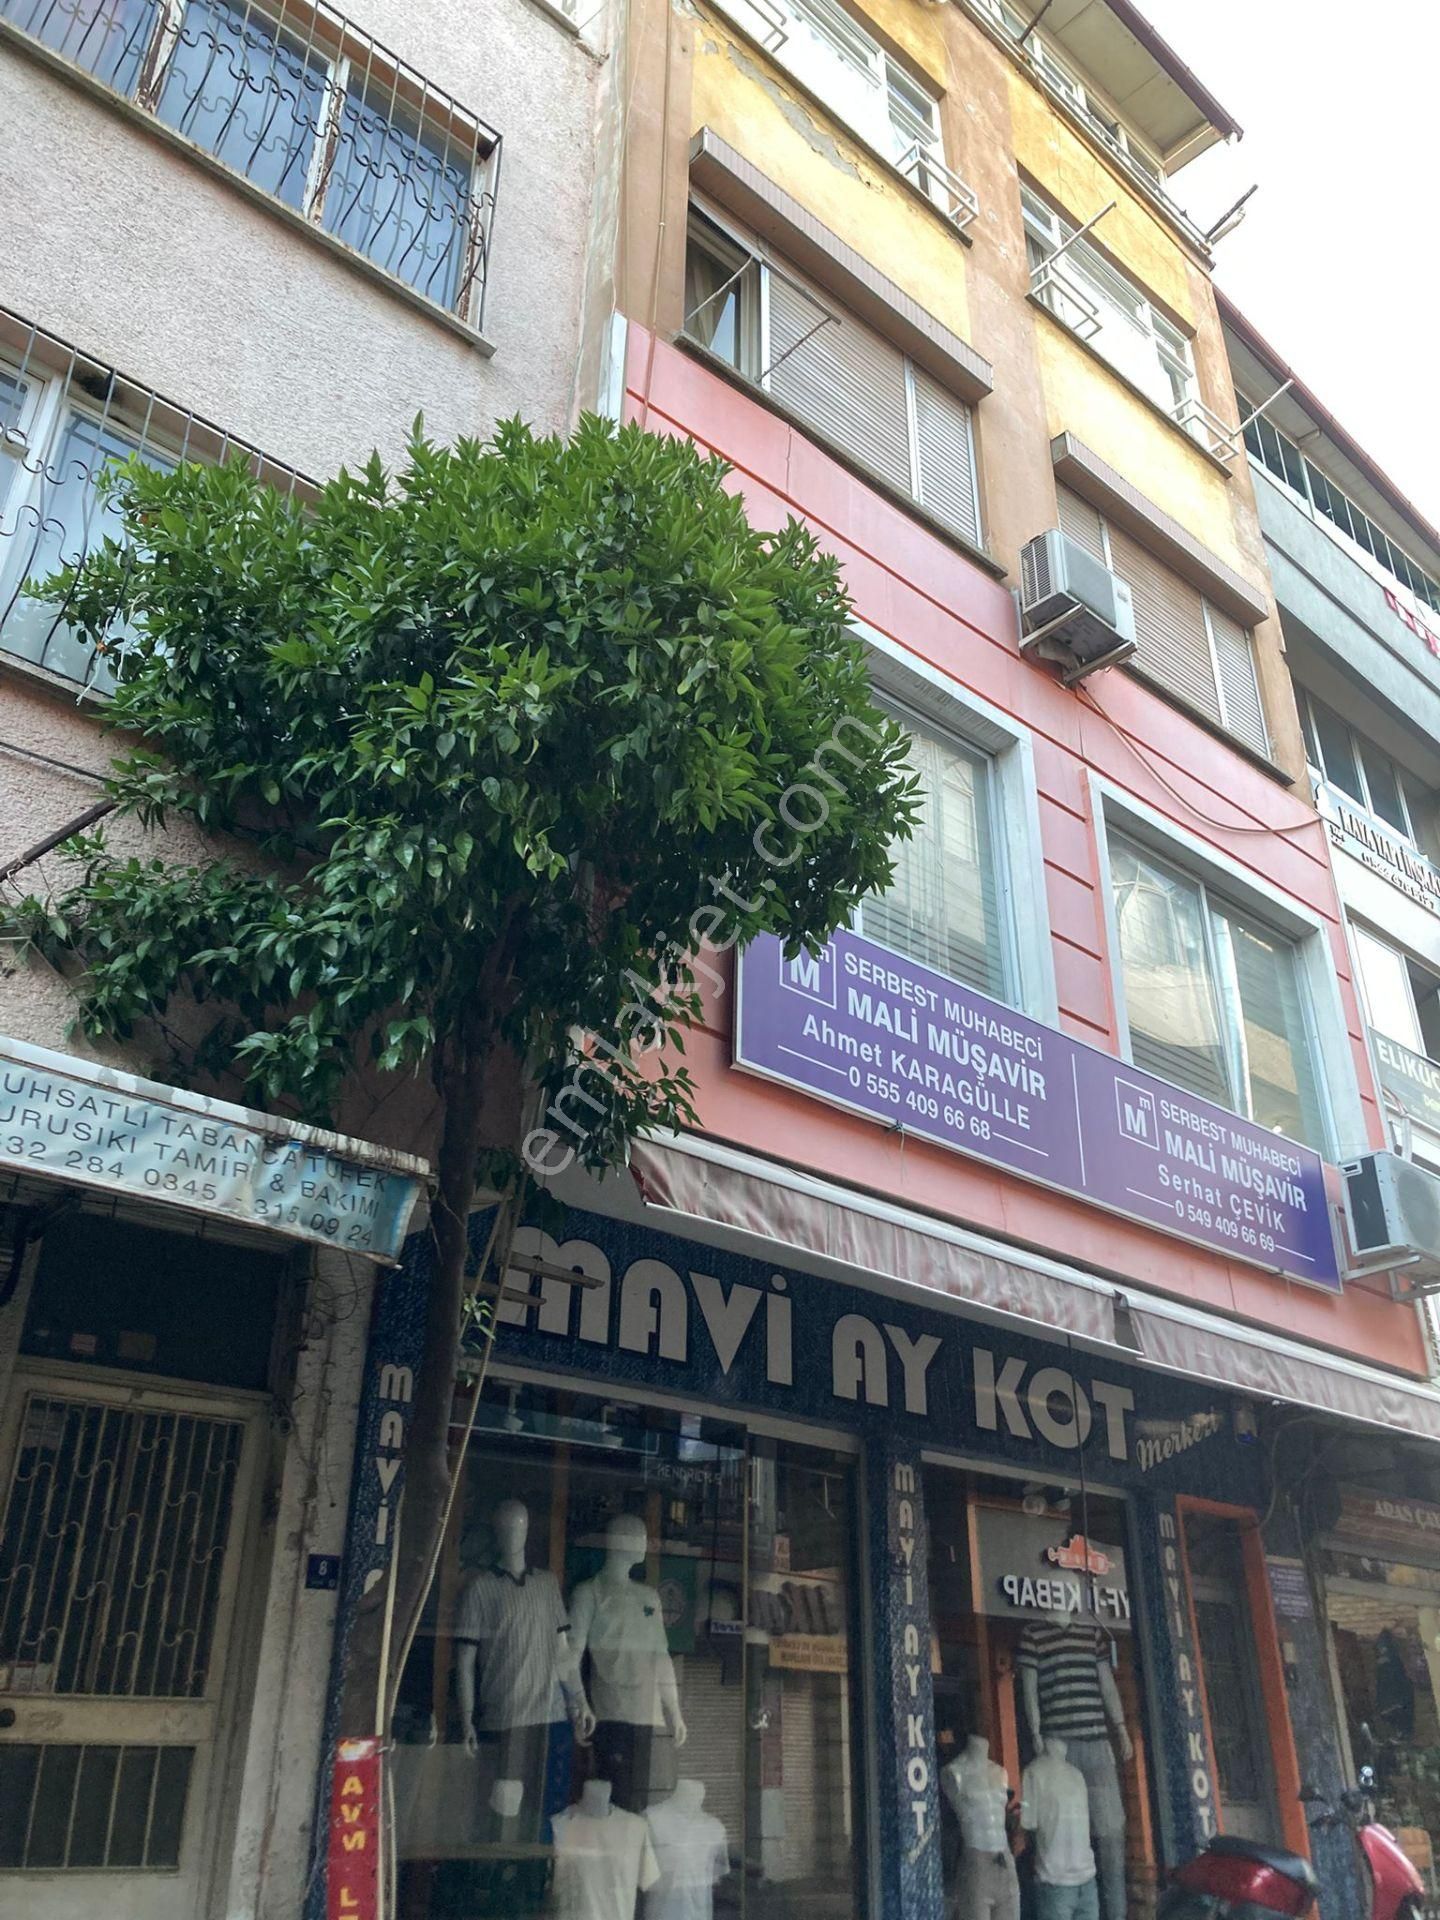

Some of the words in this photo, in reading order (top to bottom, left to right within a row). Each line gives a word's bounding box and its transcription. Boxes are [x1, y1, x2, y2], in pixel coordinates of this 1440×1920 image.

[844, 952, 939, 1012] SERBEST
[944, 998, 1043, 1062] MUHABECİ
[847, 987, 919, 1045] MALİ
[927, 1023, 1047, 1101] MÜŞAVİR
[802, 1014, 883, 1068] Ahmet
[891, 1050, 1031, 1130] KARAGÜLLE
[849, 1066, 861, 1087] 0
[866, 1072, 901, 1104] 555
[905, 1089, 939, 1119] 409
[943, 1105, 965, 1130] 66
[969, 1116, 992, 1141] 68
[3, 1072, 148, 1129] UHSATLI
[160, 1116, 297, 1166] TABANCA
[1160, 1099, 1227, 1145] SERBEST
[1231, 1131, 1303, 1178] MUHABECİ
[0, 1132, 47, 1160] 32
[65, 1149, 125, 1179] 284
[144, 1167, 217, 1200] 0345
[254, 1198, 300, 1224] 315
[309, 1213, 340, 1236] 09
[347, 1224, 373, 1246] 24
[153, 1141, 251, 1179] TAMİR
[269, 1173, 285, 1194] &
[301, 1180, 380, 1219] BAKIMI
[1158, 1164, 1223, 1209] Serhat
[1230, 1193, 1286, 1234] ÇEVİK
[1165, 1130, 1217, 1174] MALİ
[1222, 1154, 1308, 1212] MÜŞAVİR
[1175, 1200, 1184, 1217] 0
[1187, 1203, 1212, 1228] 549
[1214, 1214, 1239, 1239] 409
[1241, 1223, 1257, 1246] 66
[1259, 1229, 1275, 1253] 69
[831, 1313, 943, 1417] AY
[972, 1347, 1136, 1461] KOT
[318, 1559, 328, 1576] 8
[903, 1623, 920, 1698] AY
[907, 1714, 930, 1836] KOT
[1187, 1731, 1217, 1838] KOT
